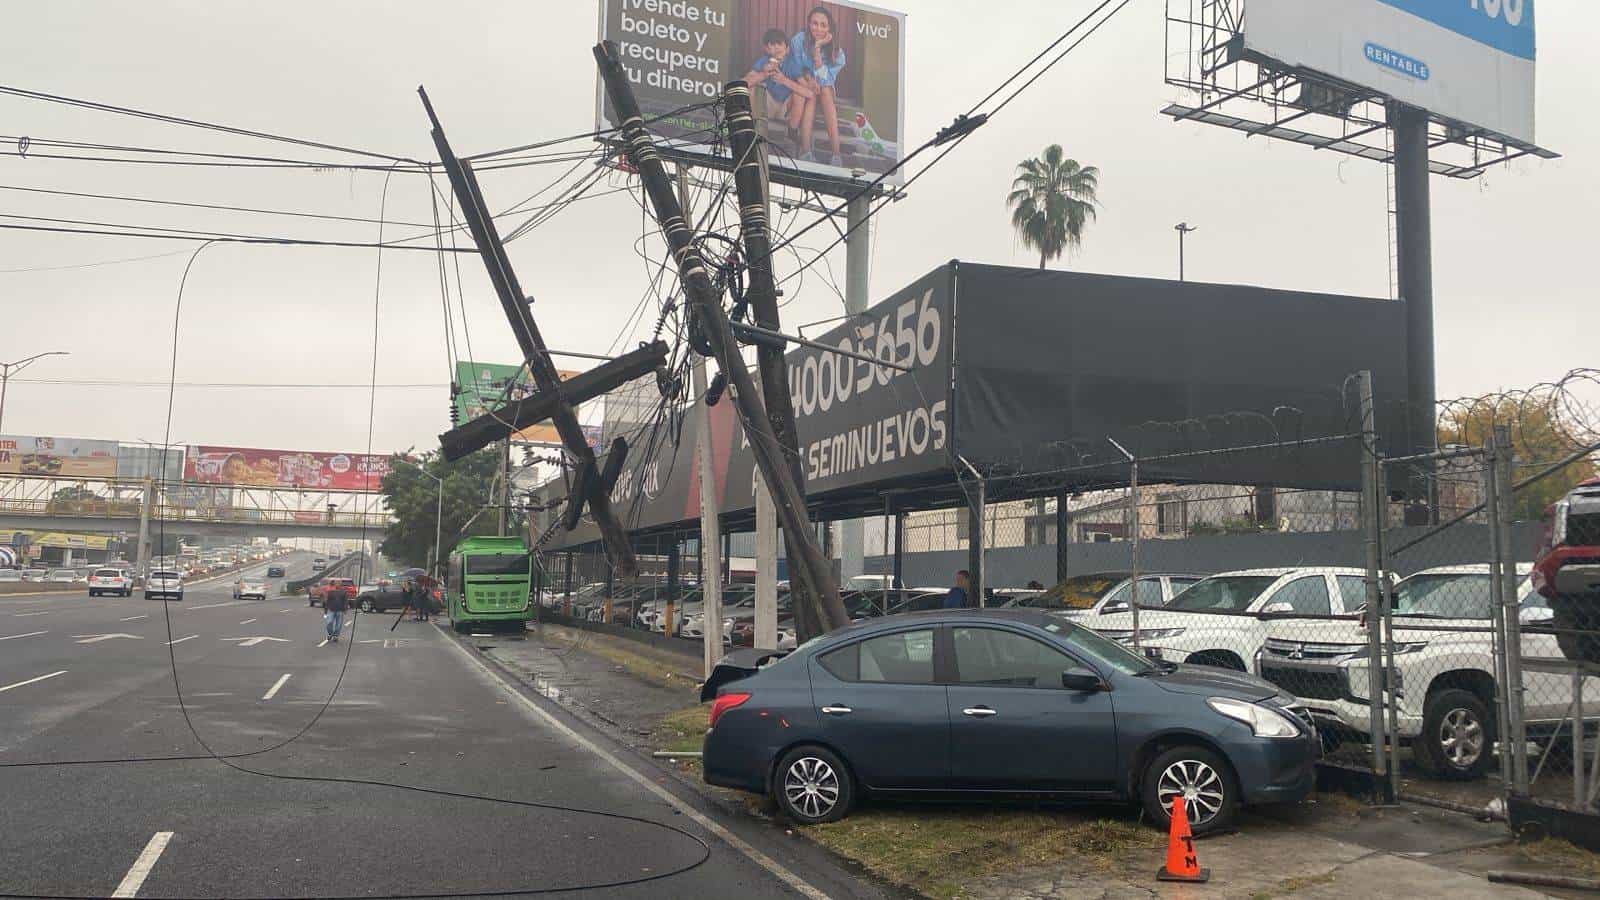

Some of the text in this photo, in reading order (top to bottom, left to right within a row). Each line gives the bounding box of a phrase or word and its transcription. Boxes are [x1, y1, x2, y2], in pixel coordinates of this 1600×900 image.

[621, 11, 708, 52] boleto y
[703, 6, 726, 27] tu
[620, 40, 719, 74] recupera
[1366, 45, 1427, 78] RENTABLE
[646, 68, 722, 97] dinero!
[807, 399, 946, 481] SEMINUEVOS
